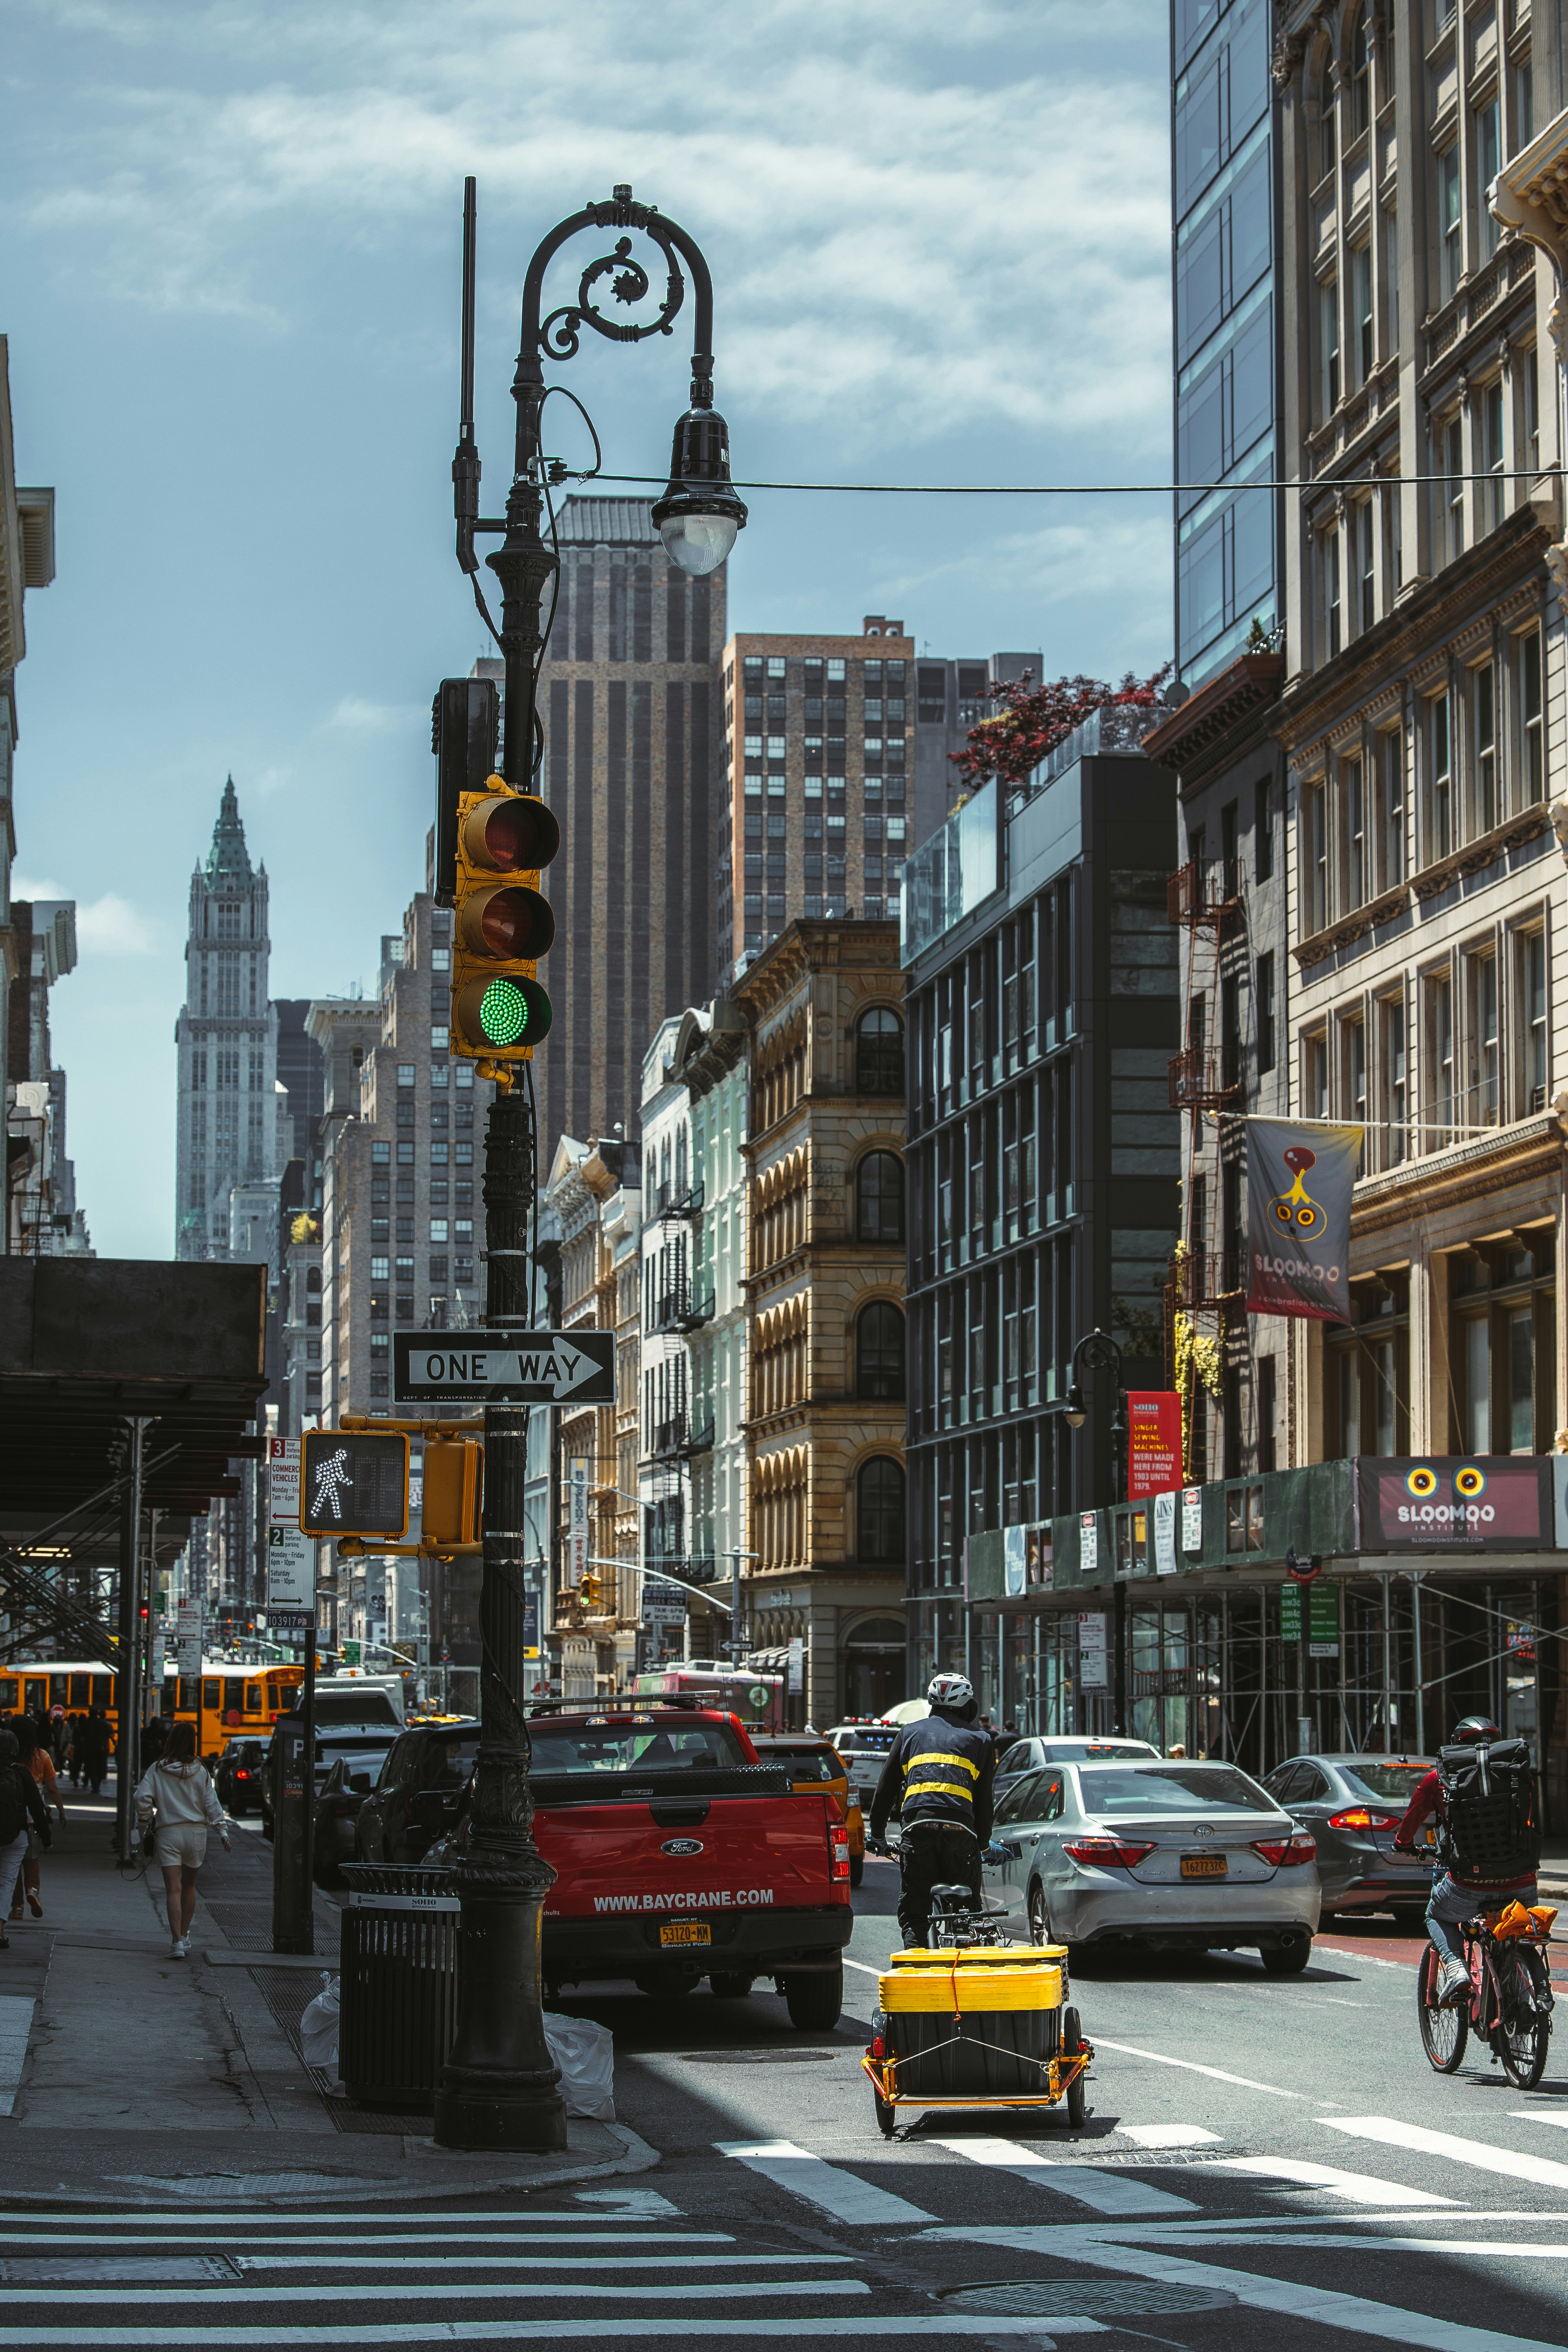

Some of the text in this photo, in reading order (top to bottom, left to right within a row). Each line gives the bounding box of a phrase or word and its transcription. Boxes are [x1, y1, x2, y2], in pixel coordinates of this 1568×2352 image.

[1255, 1254, 1340, 1283] SLOOMOO
[426, 1354, 582, 1381] ONE WAY
[274, 1440, 282, 1456] 3
[1133, 1453, 1175, 1461] WERE MADE
[273, 1464, 300, 1473] COMMERC
[1152, 1463, 1172, 1471] FROM
[273, 1474, 298, 1482] VEHICLES
[1150, 1473, 1170, 1481] UNTIL
[1398, 1504, 1495, 1525] SLOOMOO
[273, 1529, 281, 1545] 2
[269, 1616, 297, 1626] 103917
[294, 1739, 303, 1758] P
[671, 1842, 694, 1853] Ford
[1185, 1861, 1225, 1873] T627232C
[594, 1889, 773, 1911] WWW.BAYCRANE.COM
